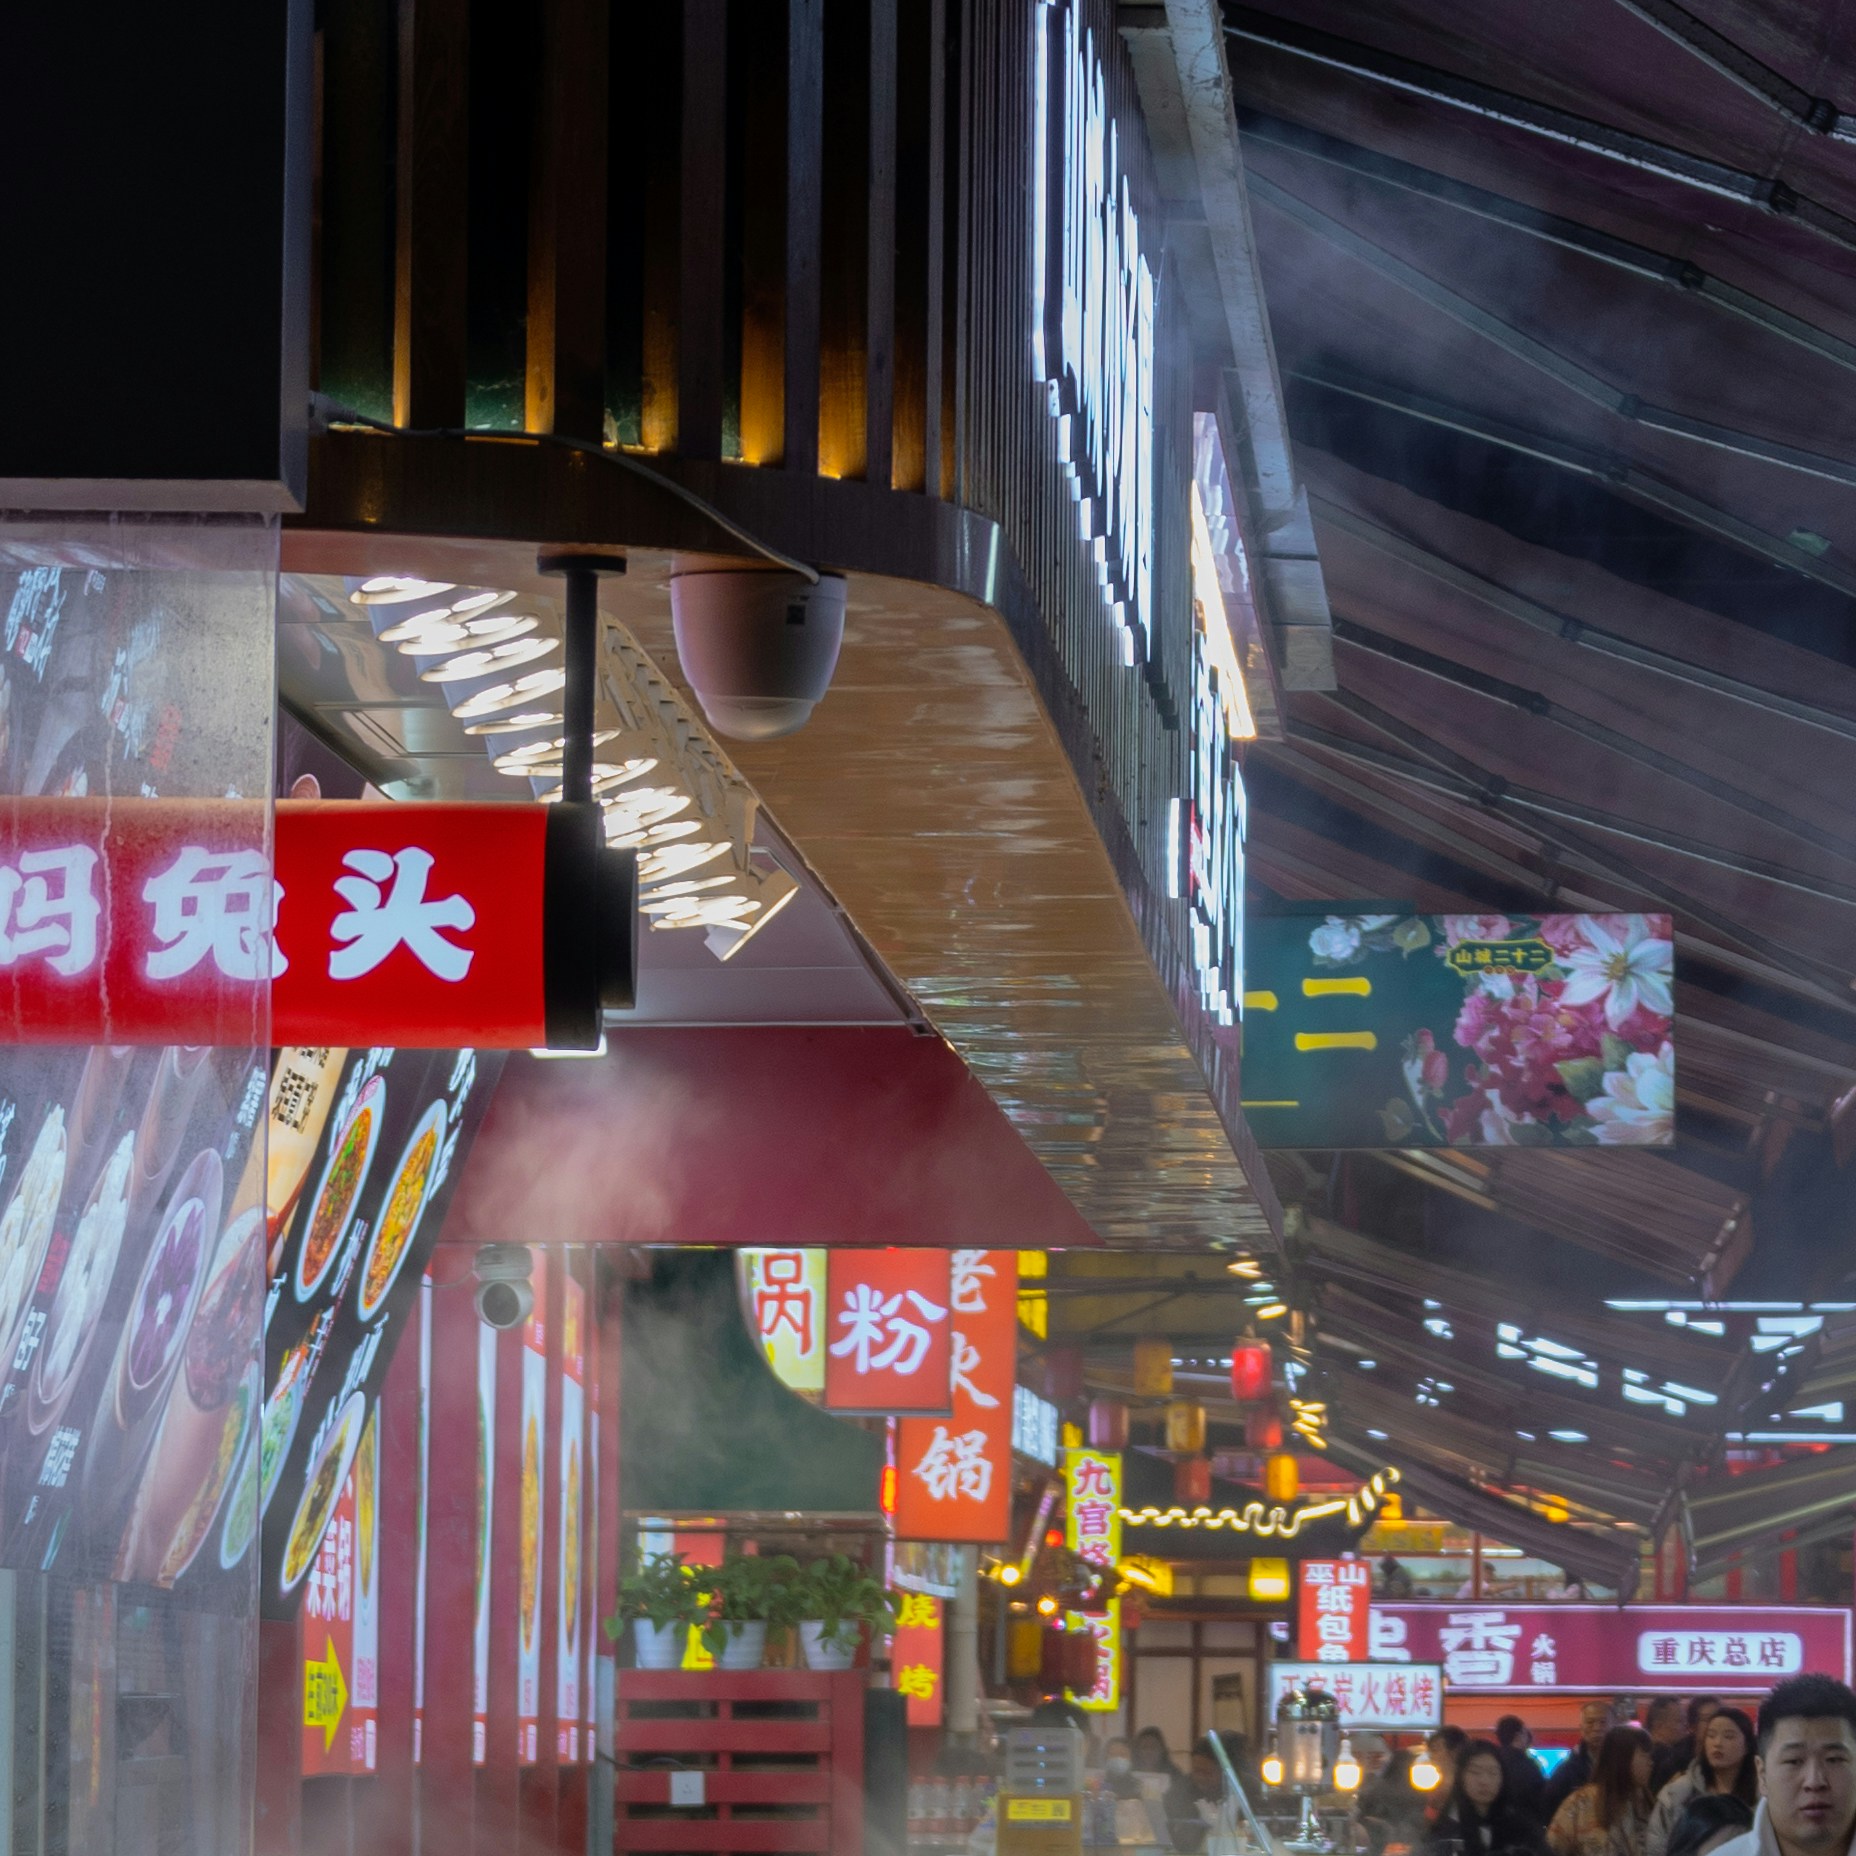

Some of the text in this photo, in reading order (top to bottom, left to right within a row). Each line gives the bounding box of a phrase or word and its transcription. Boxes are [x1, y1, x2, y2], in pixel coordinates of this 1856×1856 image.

[830, 1283, 949, 1376] 粉
[1305, 1563, 1367, 1586] 巫山
[895, 1594, 940, 1701] 烧烤
[1651, 1638, 1788, 1667] 重庆总店
